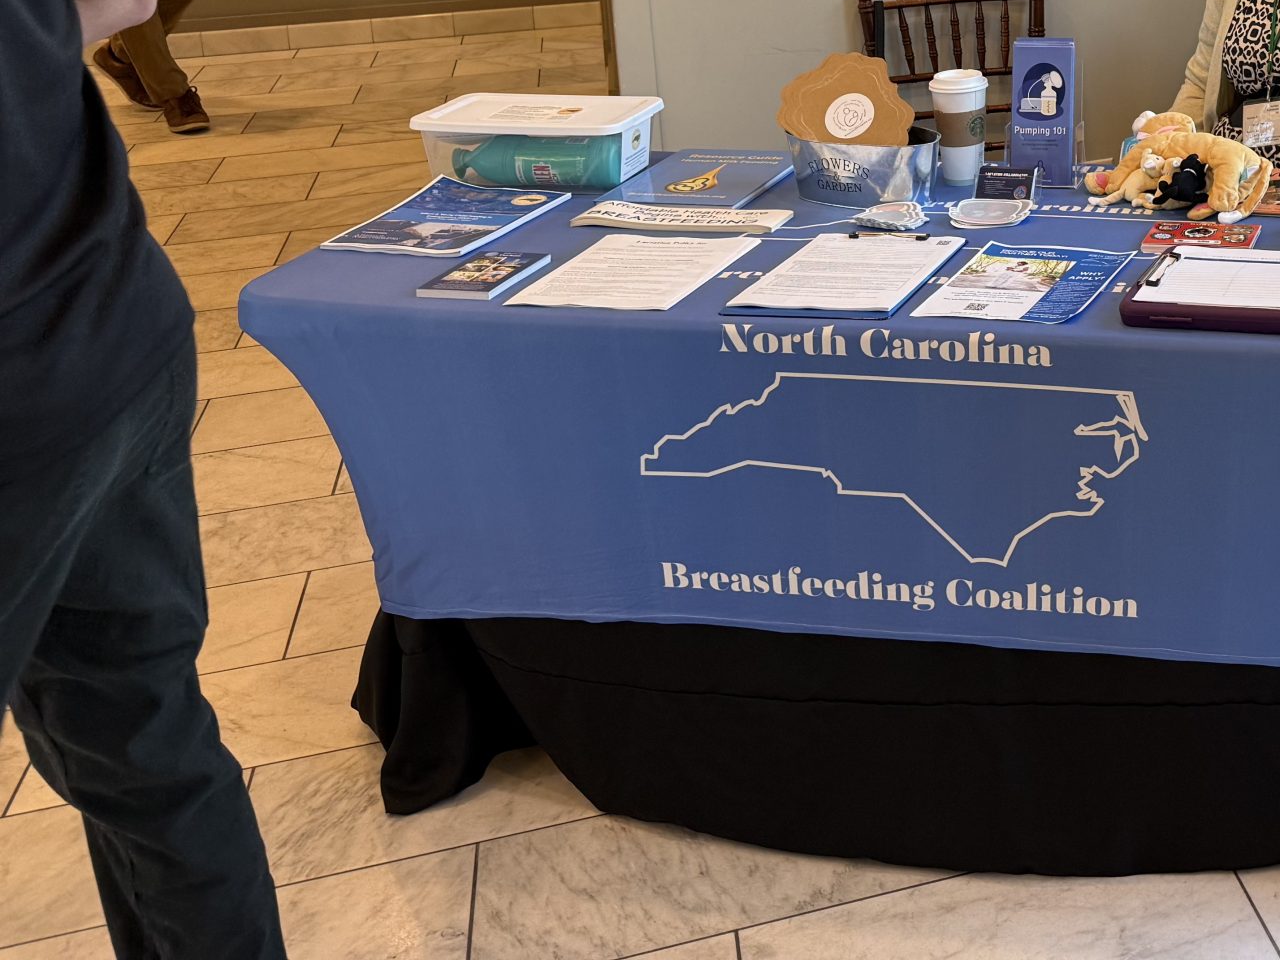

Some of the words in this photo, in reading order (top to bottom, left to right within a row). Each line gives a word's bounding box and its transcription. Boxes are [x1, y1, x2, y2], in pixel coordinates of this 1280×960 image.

[1014, 126, 1051, 136] Pumping
[1053, 126, 1066, 135] 101
[807, 157, 870, 180] FLOWERS
[833, 171, 841, 182] &
[817, 178, 862, 193] GARDEN
[604, 201, 680, 214] Affordable
[587, 209, 758, 225] BREASTFEEDING
[718, 323, 848, 356] North
[860, 327, 1054, 368] Carolina
[659, 561, 936, 611] Breastfeeding
[945, 578, 1139, 618] Coalition
